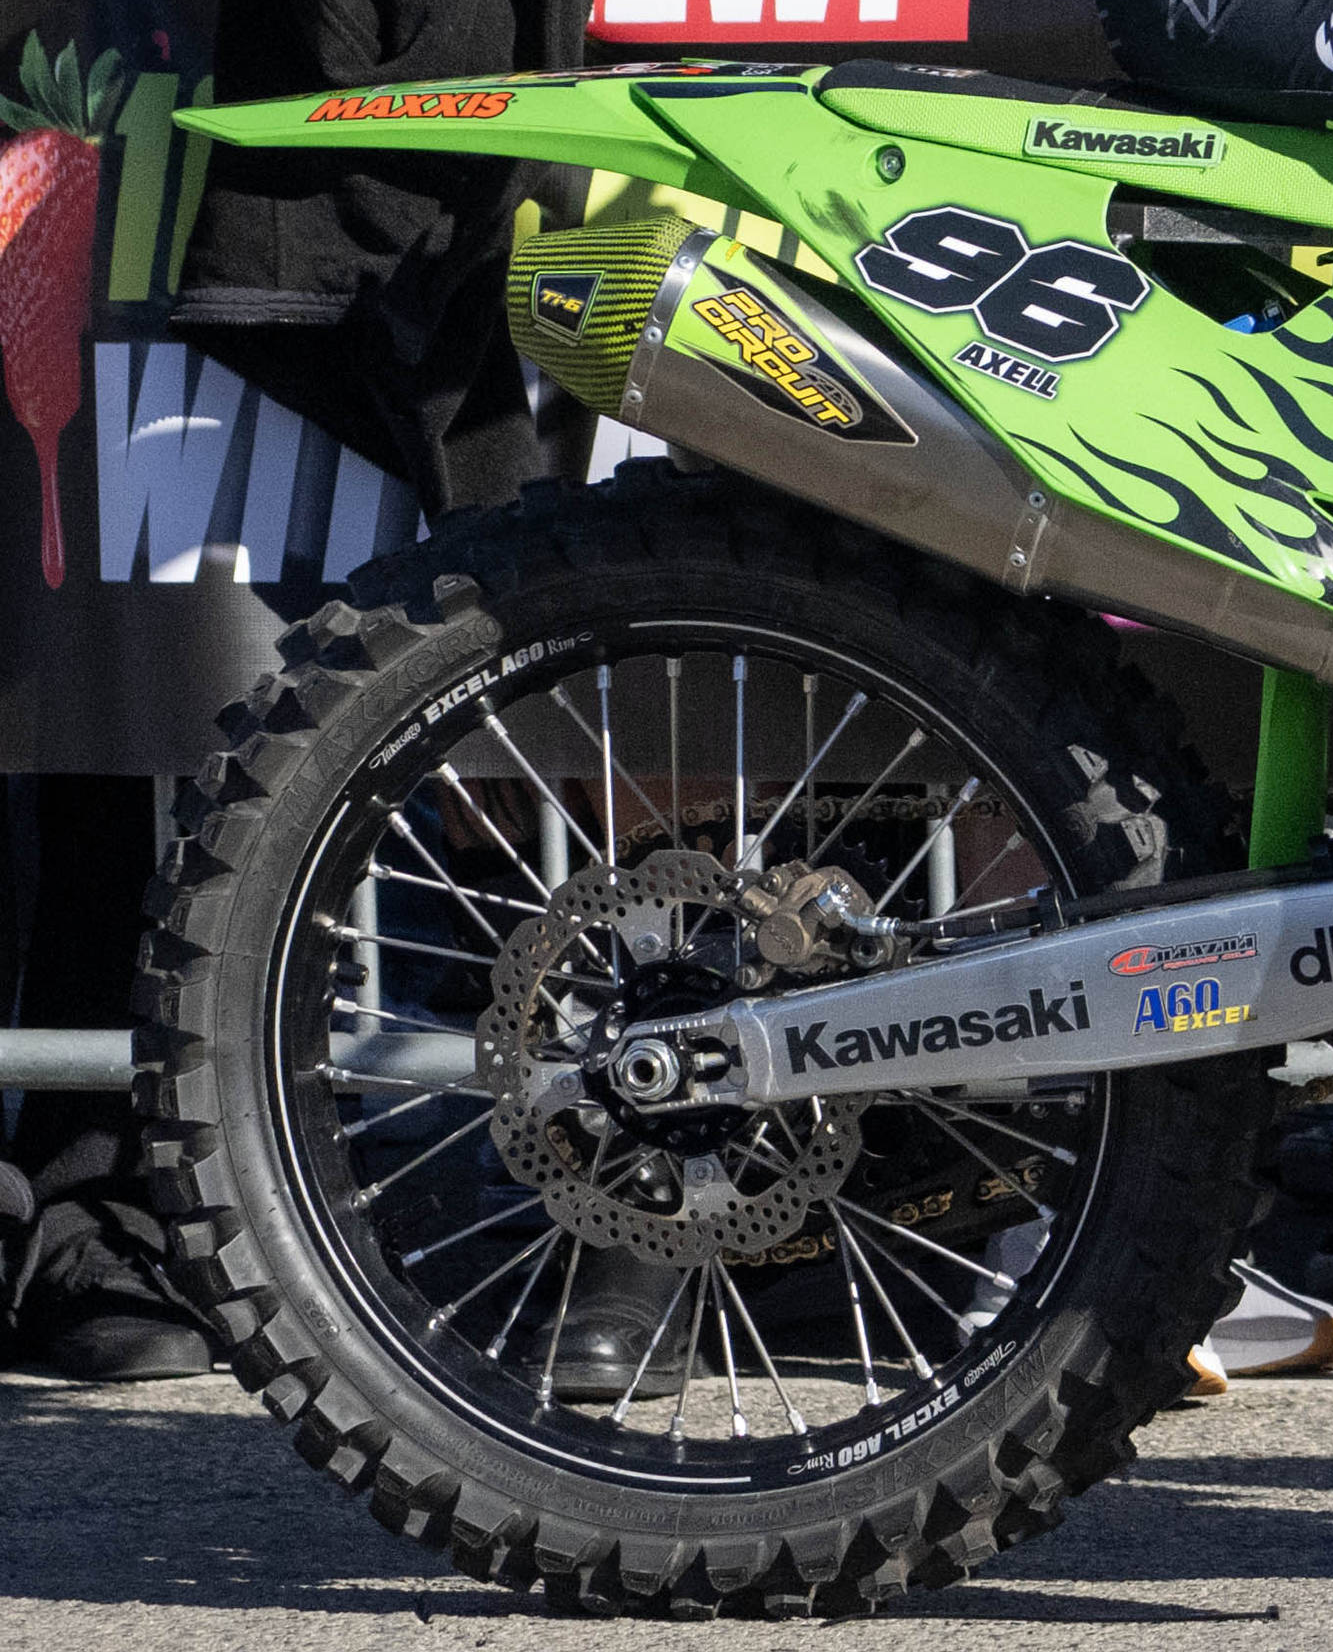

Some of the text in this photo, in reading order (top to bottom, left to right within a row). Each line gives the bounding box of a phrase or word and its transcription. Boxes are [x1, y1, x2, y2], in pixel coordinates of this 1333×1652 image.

[306, 91, 516, 123] MAXXIS
[1033, 121, 1216, 160] Kawasaki
[540, 288, 584, 314] Ti-6
[722, 290, 815, 365] PRO
[692, 298, 850, 426] CIRCUIT
[957, 344, 1059, 398] AXELL
[422, 668, 499, 725] EXCEL
[502, 643, 544, 676] A60
[785, 981, 1091, 1074] Kawasaki
[1132, 977, 1221, 1036] A60
[1173, 1004, 1256, 1033] EXCEL
[886, 1384, 961, 1440] EXCEL
[837, 1432, 883, 1467] A60
